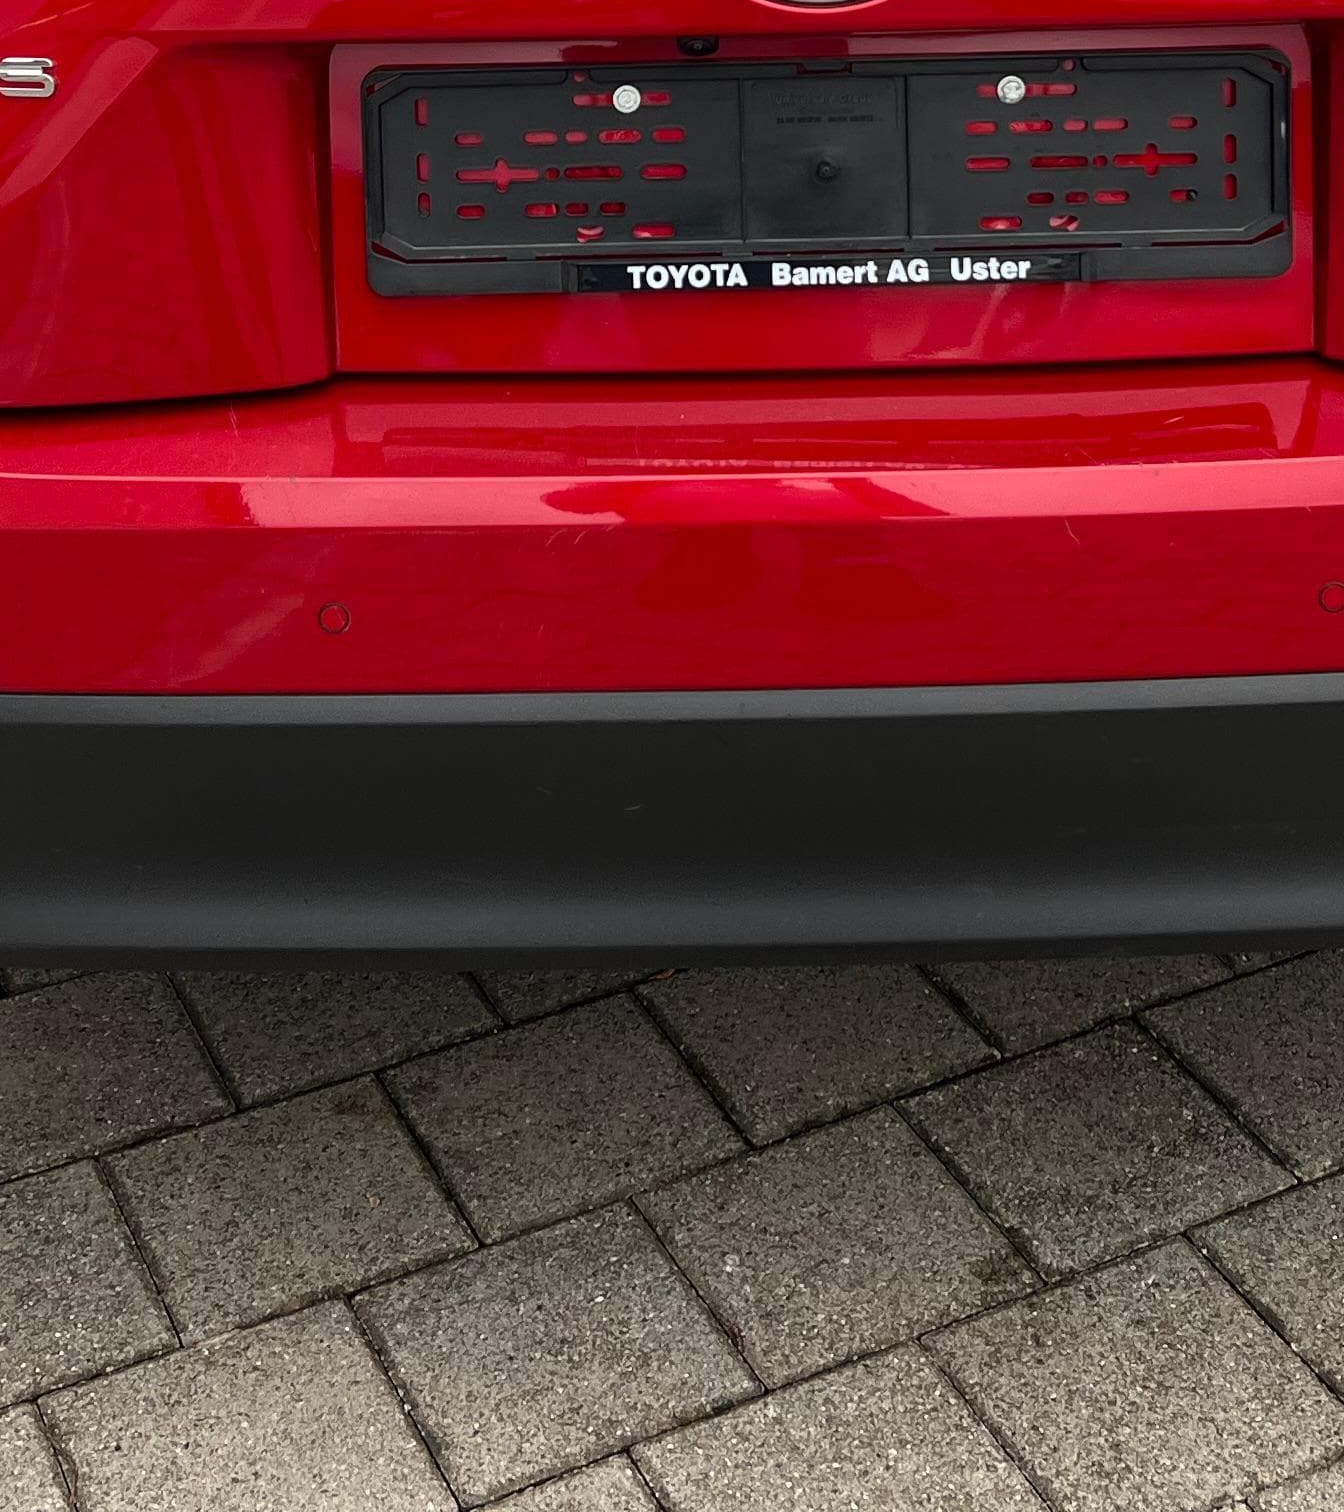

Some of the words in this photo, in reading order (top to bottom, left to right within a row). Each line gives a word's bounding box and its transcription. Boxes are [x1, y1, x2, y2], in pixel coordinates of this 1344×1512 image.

[626, 263, 748, 289] TOYOTA
[771, 259, 878, 287] Bamert
[886, 258, 930, 284] AG
[950, 256, 1032, 282] Uster
